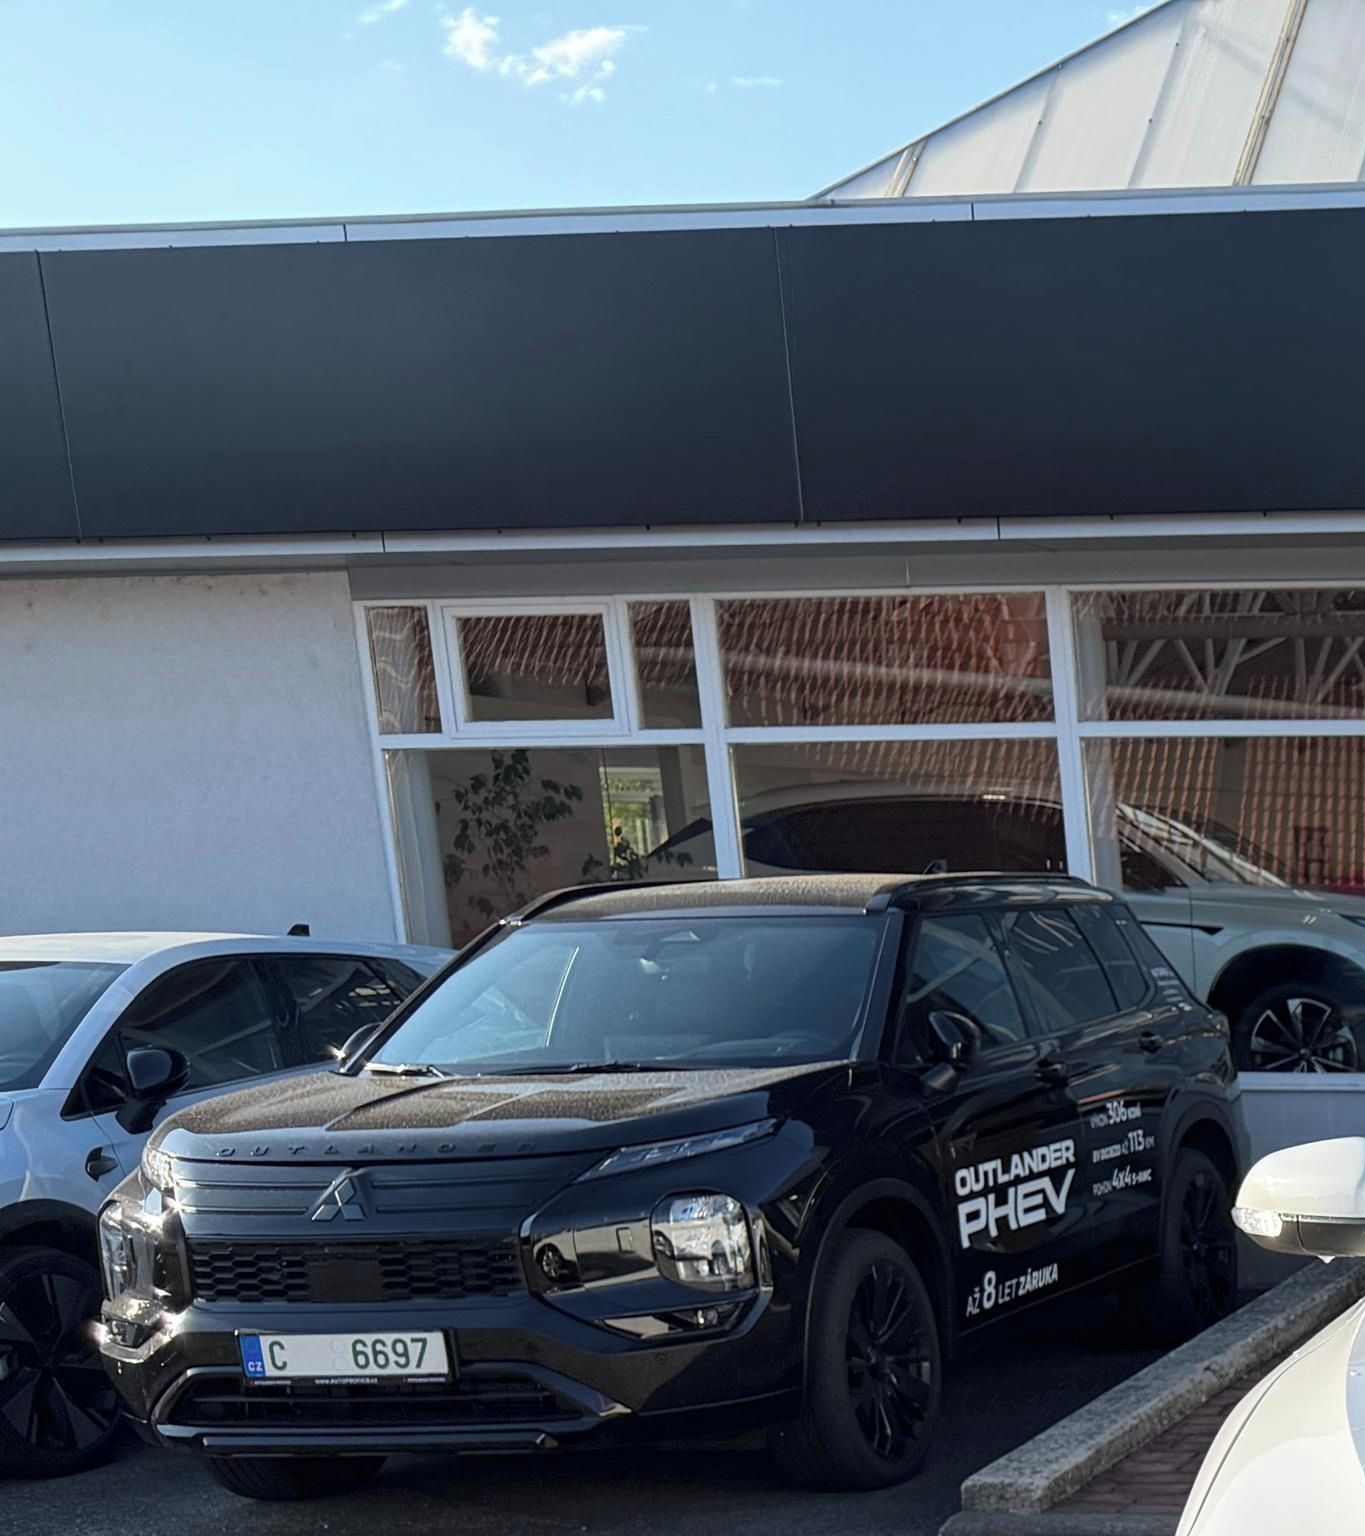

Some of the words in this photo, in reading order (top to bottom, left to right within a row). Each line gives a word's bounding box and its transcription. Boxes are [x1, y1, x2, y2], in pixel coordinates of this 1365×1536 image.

[1106, 1099, 1127, 1125] 306
[215, 1142, 537, 1157] OUTLANDER
[1128, 1129, 1145, 1152] 113
[955, 1138, 1075, 1197] OUTLANDER
[958, 1168, 1076, 1250] PHEV
[966, 1286, 980, 1317] AŽ
[983, 1270, 996, 1310] 8
[998, 1278, 1018, 1304] LET
[1018, 1263, 1058, 1296] ZÁRUKA
[248, 1361, 263, 1372] CZ
[268, 1340, 288, 1371] C
[351, 1337, 428, 1370] 6697
